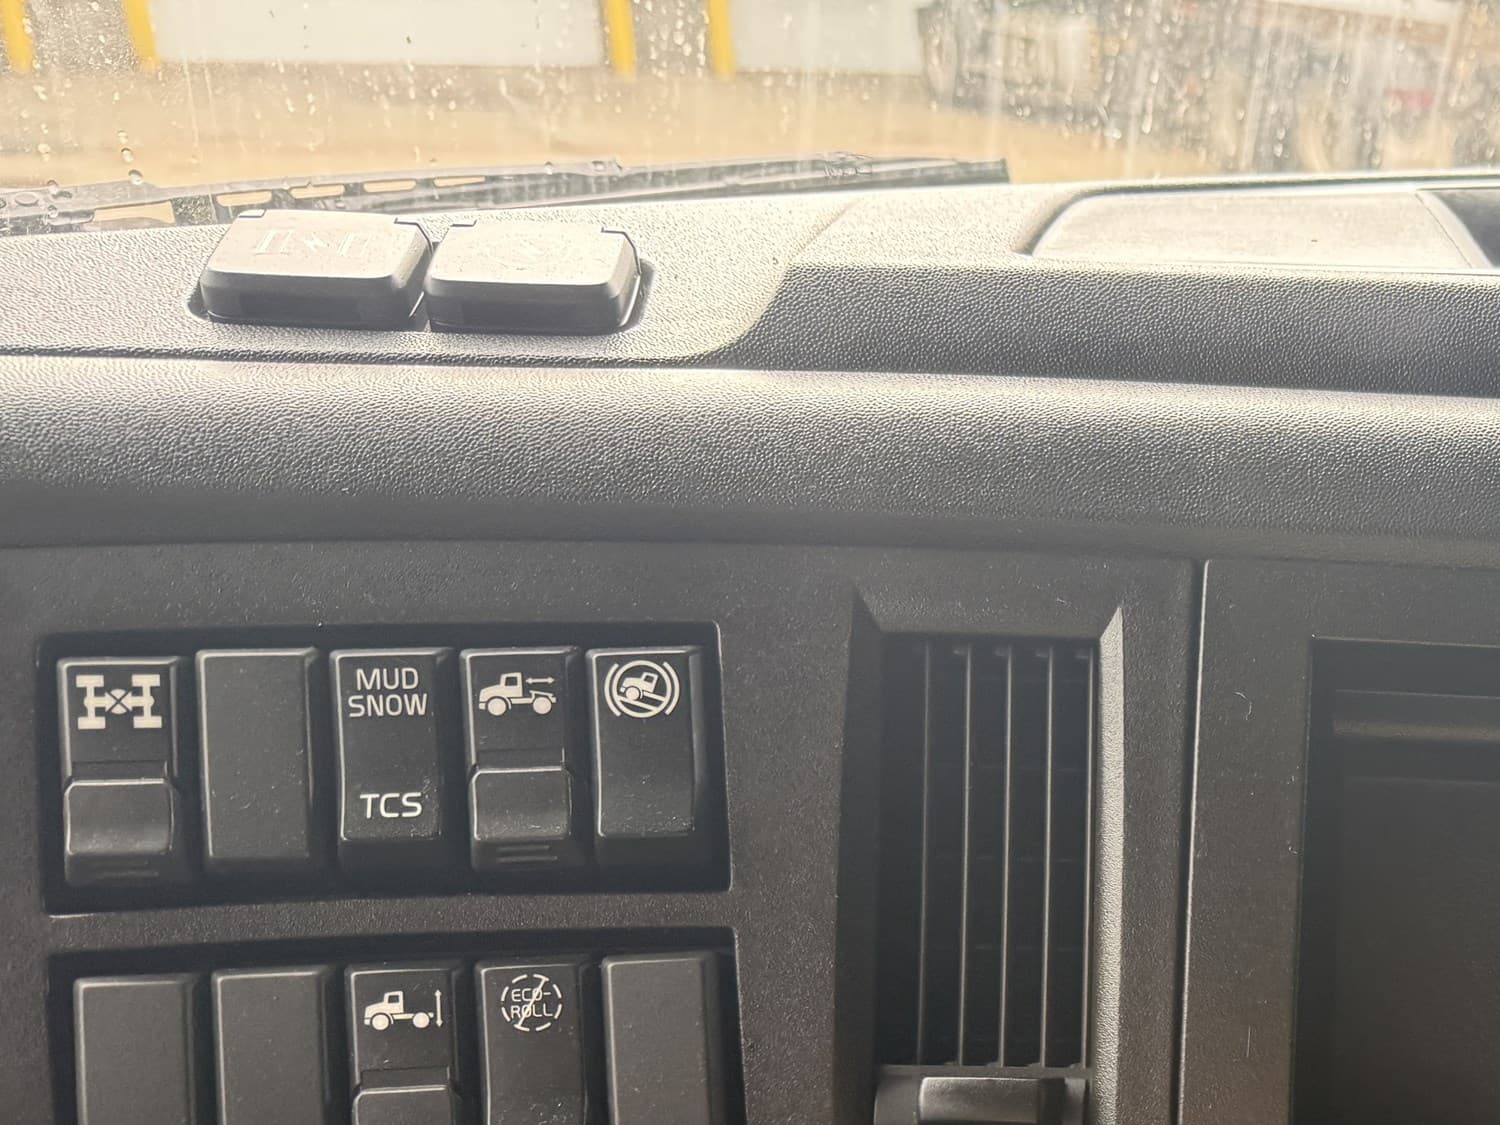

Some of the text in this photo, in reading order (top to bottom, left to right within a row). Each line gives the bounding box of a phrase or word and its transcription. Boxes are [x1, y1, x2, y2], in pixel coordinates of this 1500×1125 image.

[356, 667, 419, 691] MUD
[347, 693, 428, 718] SNOW
[359, 791, 424, 819] TCS
[511, 985, 552, 1004] ECO-
[508, 1002, 553, 1020] ROLL
